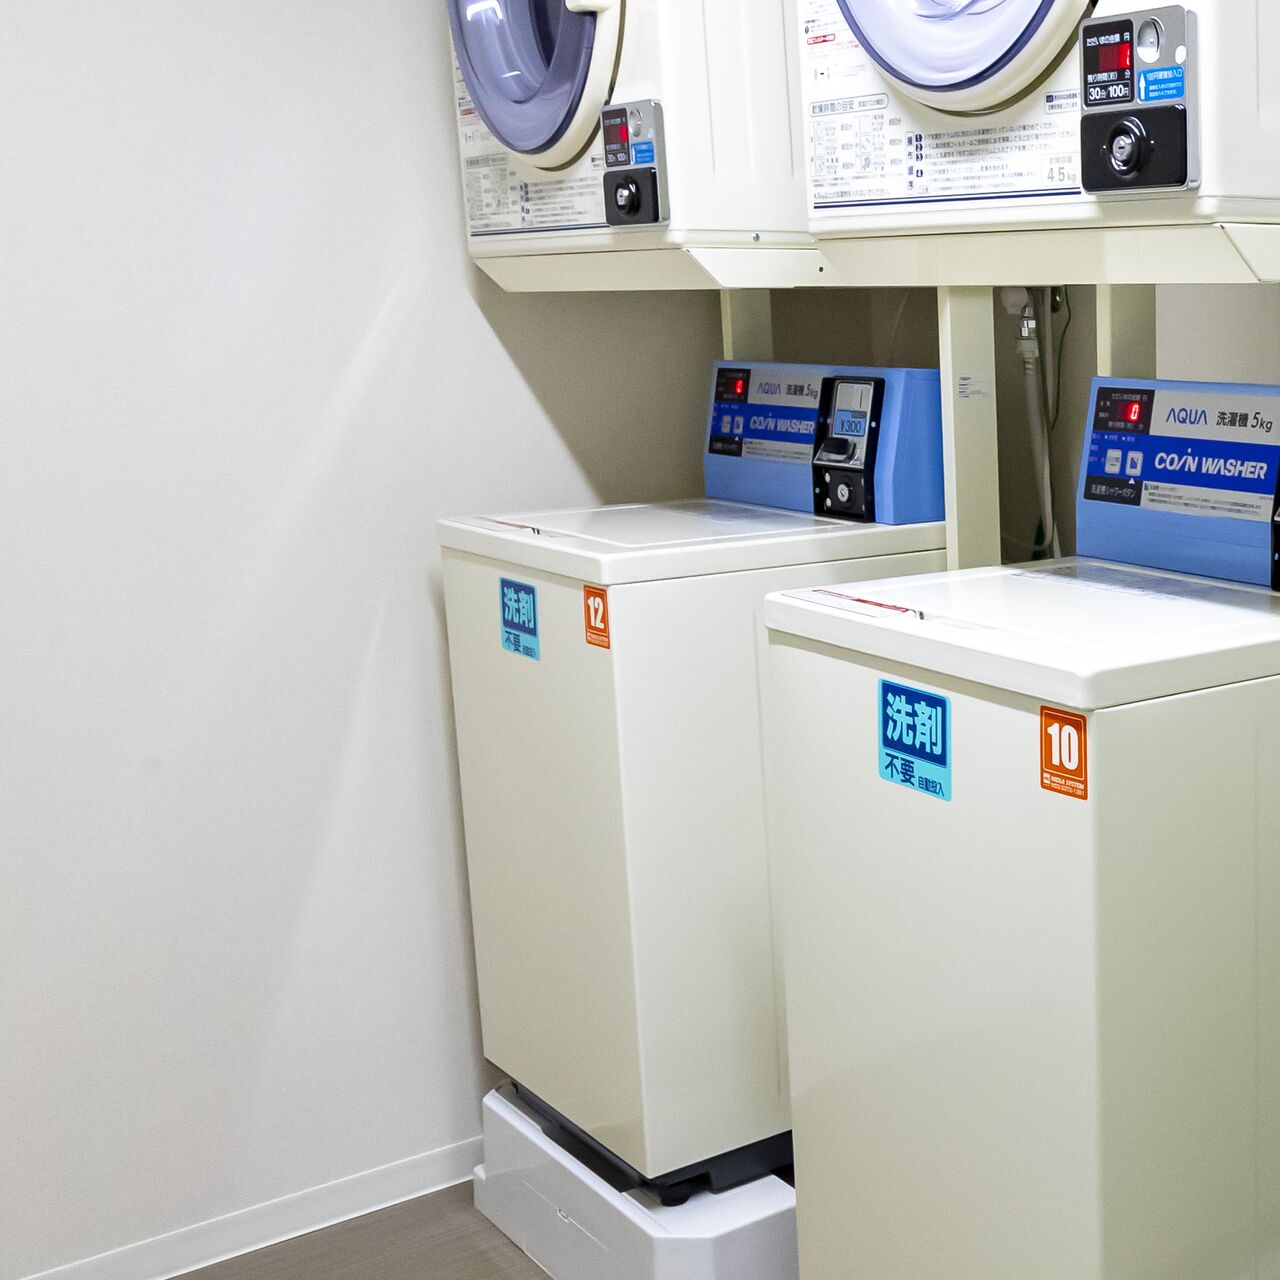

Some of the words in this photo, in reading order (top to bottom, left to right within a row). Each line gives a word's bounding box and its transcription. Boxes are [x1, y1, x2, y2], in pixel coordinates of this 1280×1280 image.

[776, 418, 815, 434] WASHER
[1130, 404, 1139, 420] 0
[1165, 407, 1208, 426] AQUA
[1215, 411, 1249, 428] 洗濯機
[1250, 411, 1273, 433] 5kg
[840, 420, 862, 434] ¥300
[1201, 454, 1268, 480] WASHER
[503, 586, 535, 629] 洗剤
[587, 596, 605, 629] 12
[886, 692, 943, 755] 洗剤
[1047, 722, 1079, 771] 10
[884, 752, 915, 787] 不要
